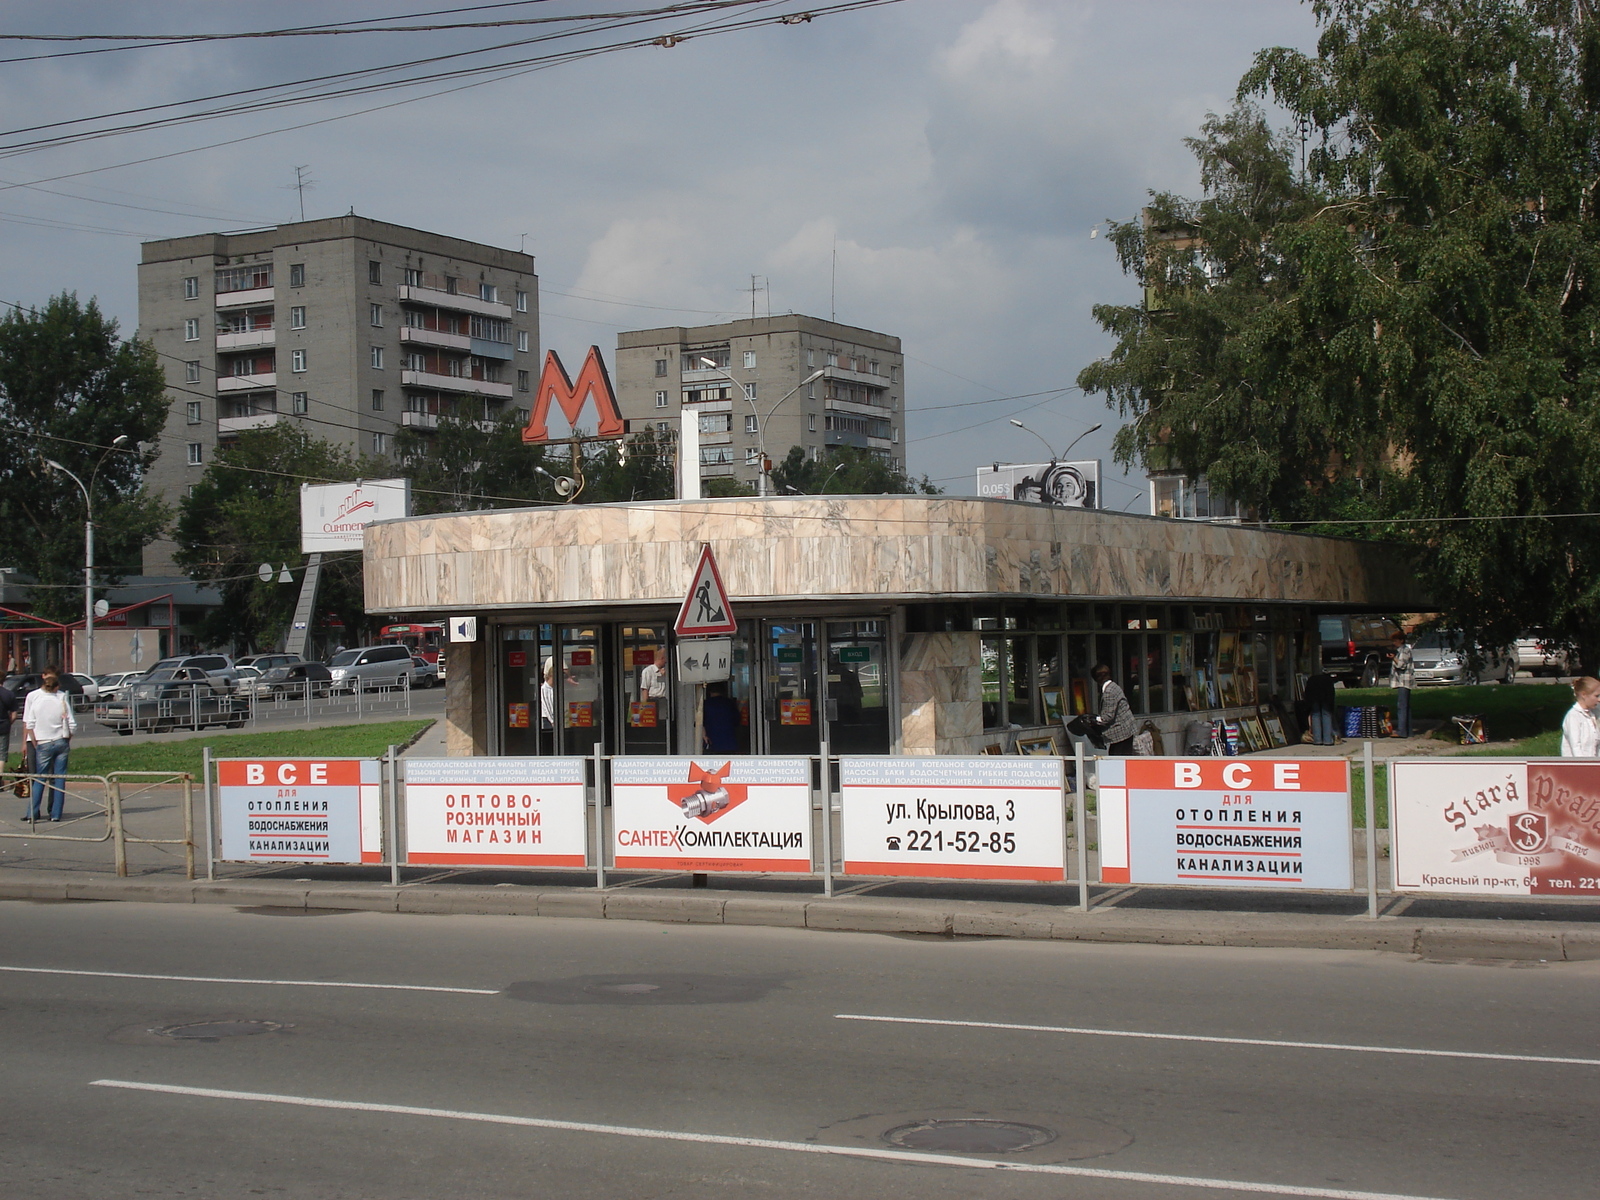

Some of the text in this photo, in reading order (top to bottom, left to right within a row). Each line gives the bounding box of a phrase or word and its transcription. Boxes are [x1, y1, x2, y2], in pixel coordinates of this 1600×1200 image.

[982, 483, 1011, 496] 0,05$
[702, 652, 710, 670] 4
[968, 761, 1033, 769] ОБОРУДОВАНИЕ
[246, 764, 328, 785] ВСЕ
[910, 769, 973, 777] ВОДОСЧЕТЧИКИ
[1011, 770, 1059, 778] ПОДВОДКИ
[1174, 763, 1301, 789] ВСЕ
[895, 777, 983, 785] ПОЛОТЕНЦЕСУШИТЕЛИ
[989, 778, 1059, 786] ТЕПЛОИЗОЛЯЦИЯ
[277, 789, 297, 798] ДЛЯ
[1222, 795, 1252, 806] ДЛЯ
[248, 801, 328, 811] ОТОПЛЕНИЯ
[445, 794, 541, 808] ОПТОВО-
[446, 809, 541, 826] РОЗНИЧНЫЙ
[886, 798, 1016, 825] ул. Крылова, 3
[1176, 808, 1301, 823] ОТОПЛЕНИЯ
[248, 821, 328, 832] ВОДОСНАБЖЕНИЯ
[446, 829, 542, 844] МАГАЗИН
[907, 830, 1016, 853] 221-52-85
[1176, 833, 1302, 848] ВОДОСНАБЖЕНИЯ
[249, 841, 330, 852] КАНАЛИЗАЦИИ
[1462, 839, 1495, 857] пивной
[1565, 842, 1589, 856] клуб
[1177, 858, 1303, 875] КАНАЛИЗАЦИИ
[1518, 856, 1541, 865] 1998
[1422, 873, 1479, 885] Красный
[1483, 878, 1519, 888] пр-кт,
[1523, 876, 1538, 887] 64
[1548, 879, 1576, 888] тел.
